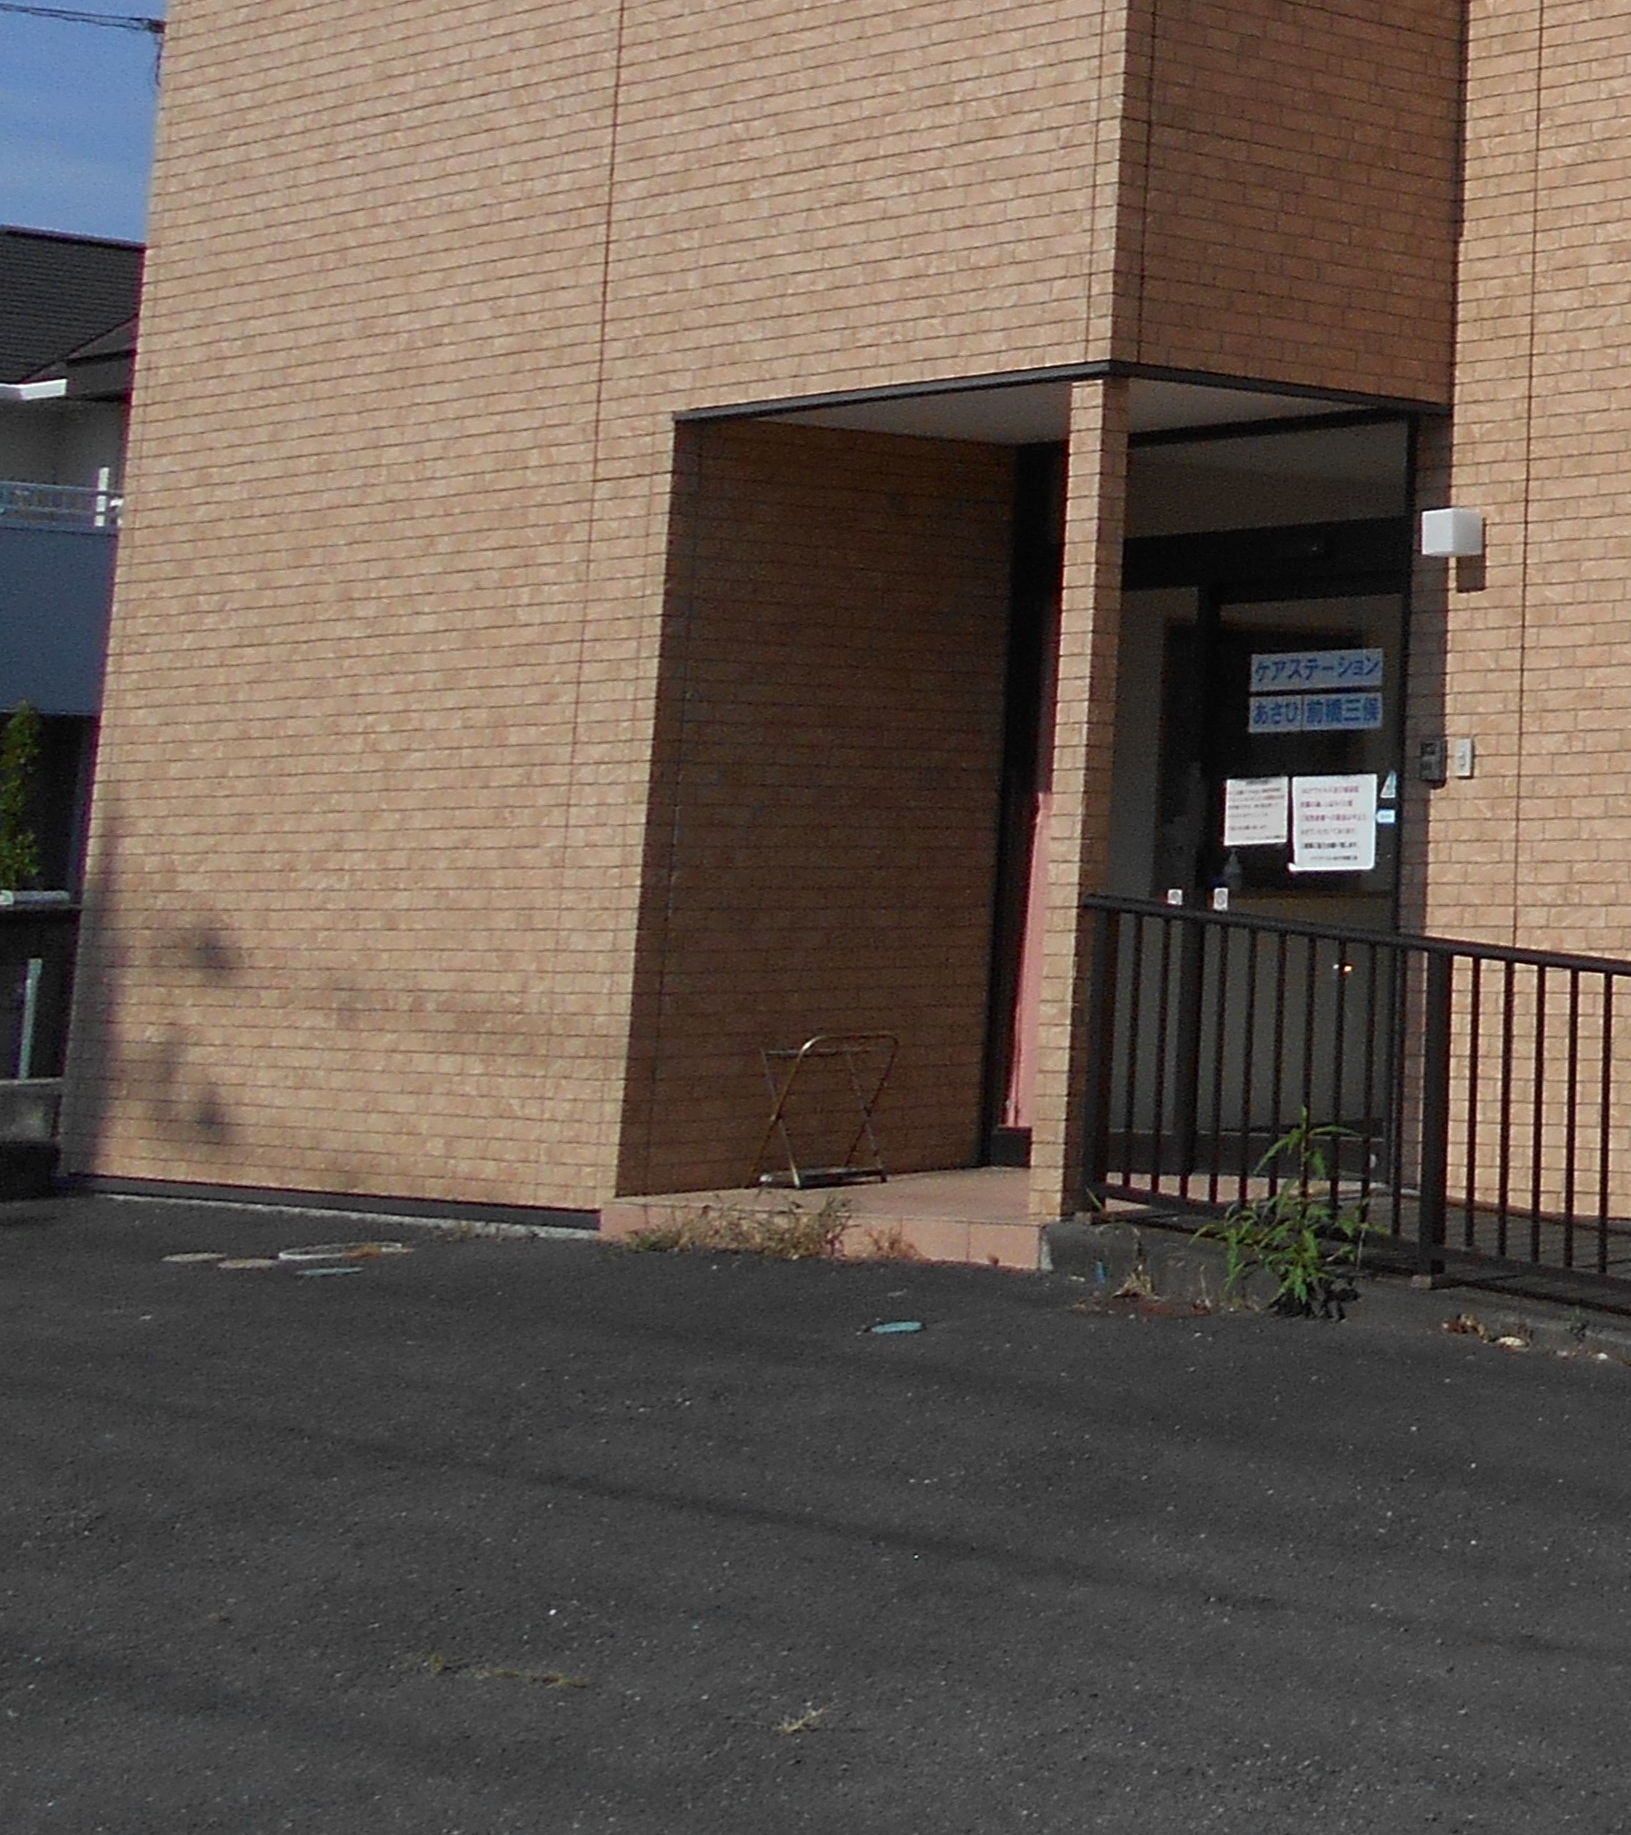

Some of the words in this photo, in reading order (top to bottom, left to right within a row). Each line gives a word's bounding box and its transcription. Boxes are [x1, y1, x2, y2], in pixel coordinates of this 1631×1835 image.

[1255, 655, 1380, 682] ケアステーション
